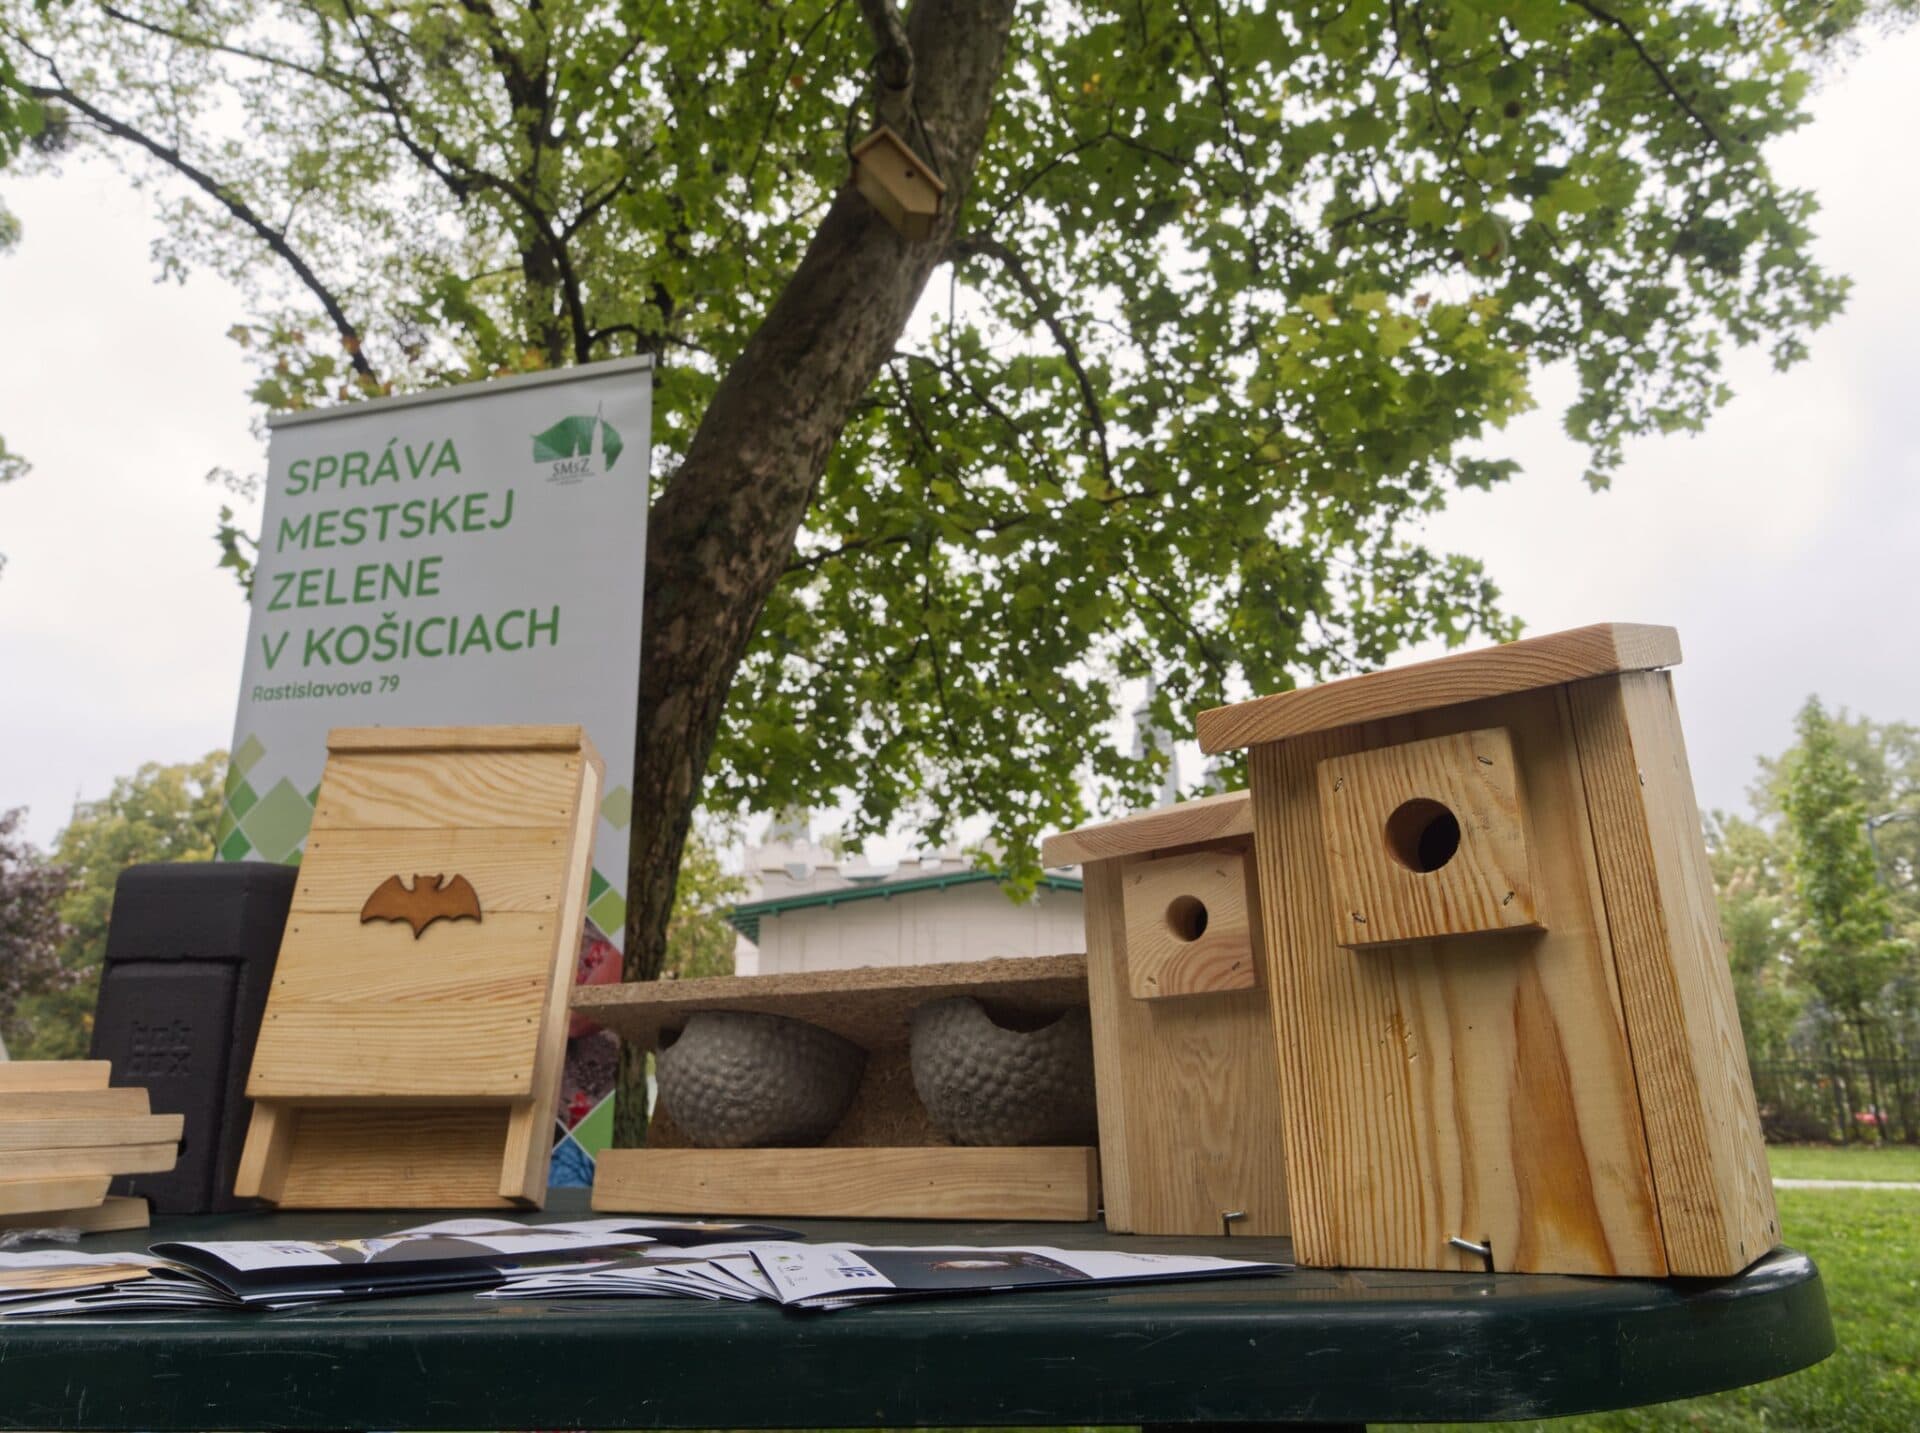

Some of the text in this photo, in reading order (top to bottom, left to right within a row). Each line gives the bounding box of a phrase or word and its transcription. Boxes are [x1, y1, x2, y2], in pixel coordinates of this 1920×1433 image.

[285, 437, 462, 497] SPRÁVA
[276, 488, 515, 553] MESTSKEJ
[266, 555, 444, 612] ZELENE
[261, 604, 561, 671] V KOŠICIACH
[252, 674, 400, 702] Rastislavova 79
